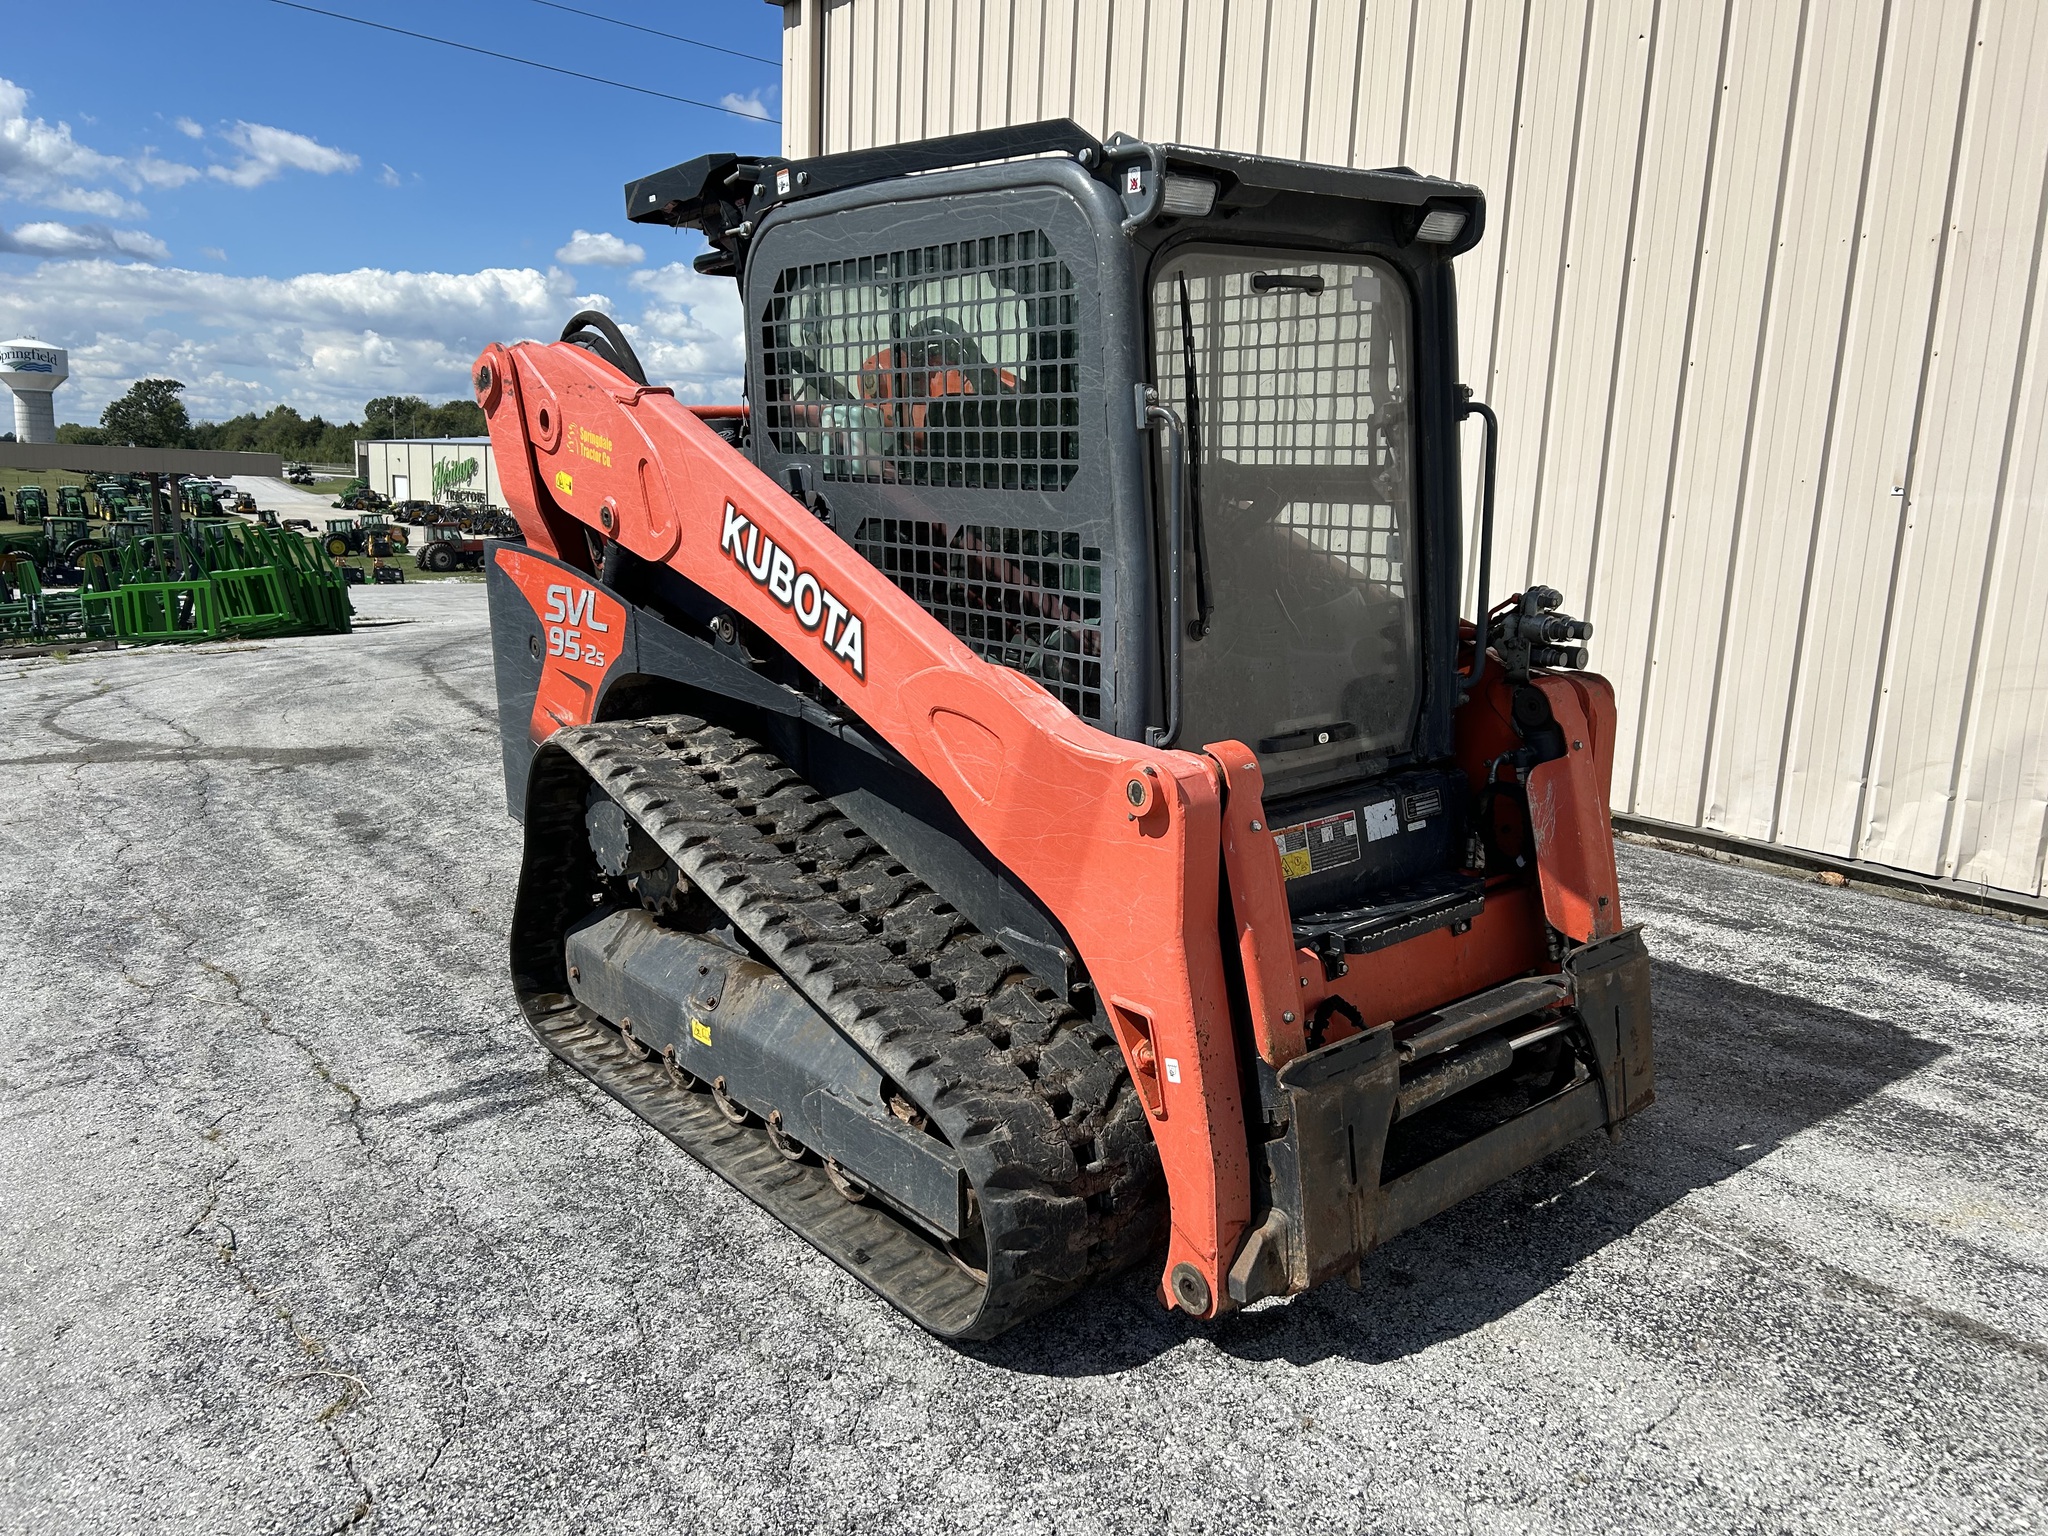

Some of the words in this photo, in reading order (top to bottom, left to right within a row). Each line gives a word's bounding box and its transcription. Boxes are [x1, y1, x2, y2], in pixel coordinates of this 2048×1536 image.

[0, 348, 58, 366] pringfield
[580, 426, 613, 452] Springdale
[580, 442, 602, 464] Tractor
[602, 451, 613, 468] Co.
[721, 501, 865, 680] KUBOTA
[545, 584, 608, 632] SVL
